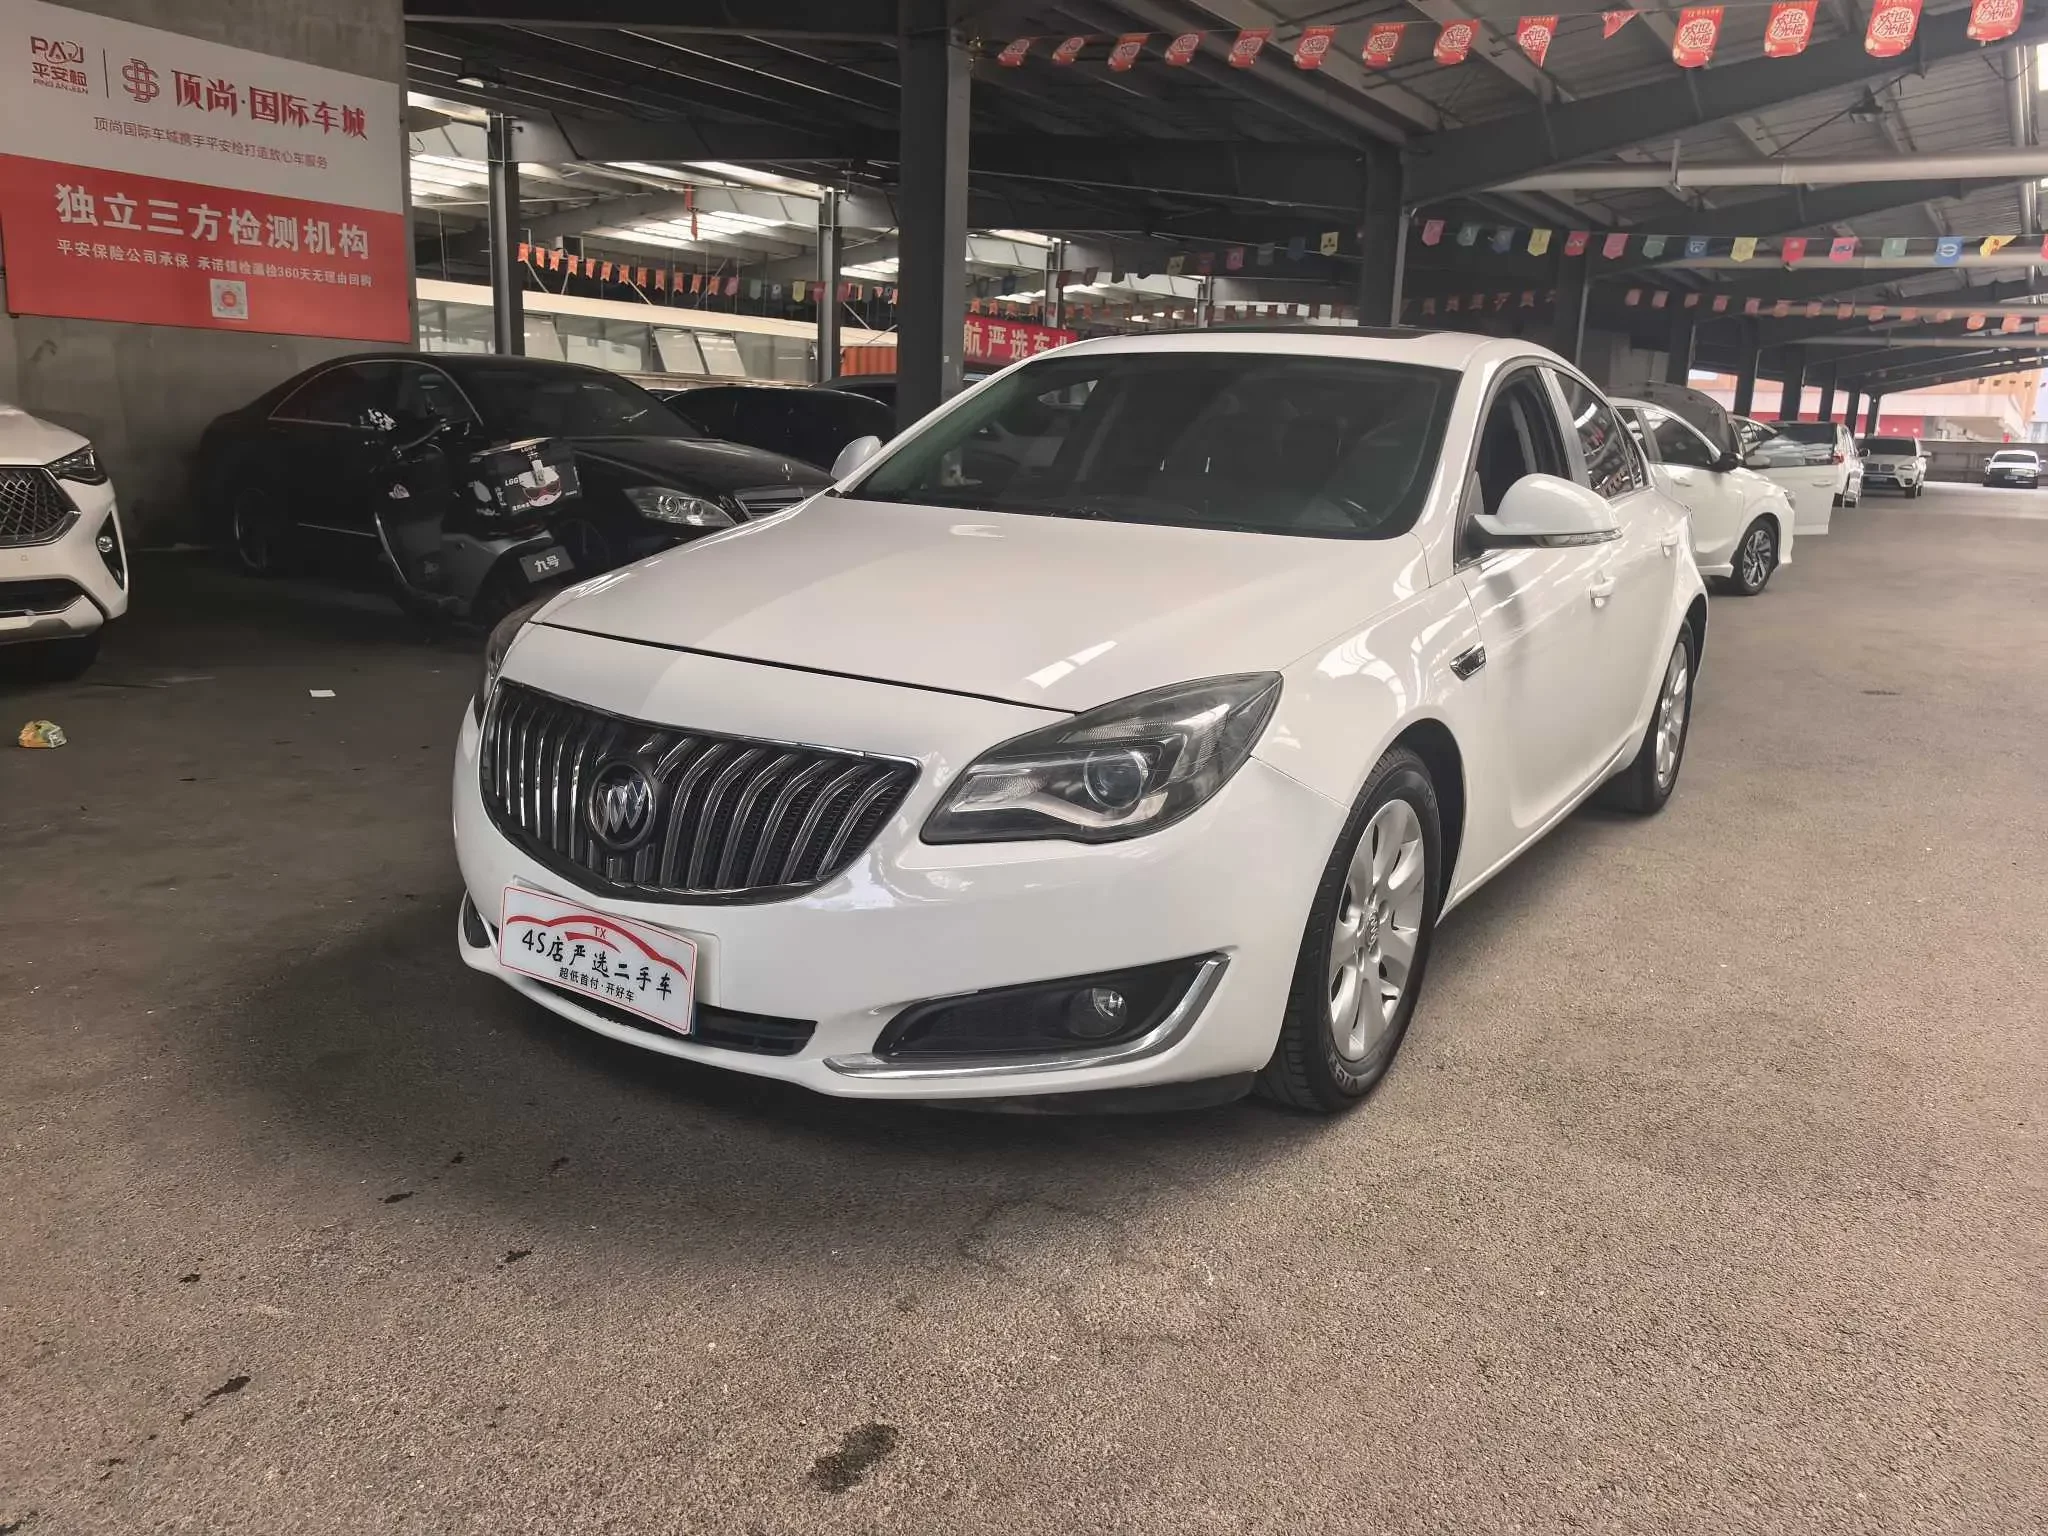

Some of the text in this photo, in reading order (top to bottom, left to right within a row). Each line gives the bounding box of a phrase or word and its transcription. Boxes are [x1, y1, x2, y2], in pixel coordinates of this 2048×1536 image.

[170, 69, 369, 141] 顶尚·国际车城
[54, 183, 370, 260] 独立三方检测机构
[56, 239, 190, 269] 平安保险公司承保
[534, 555, 560, 572] 九号
[594, 925, 608, 939] TX
[521, 929, 672, 1001] 4S店严选二手车
[558, 966, 635, 1002] 超低首付·开好车
